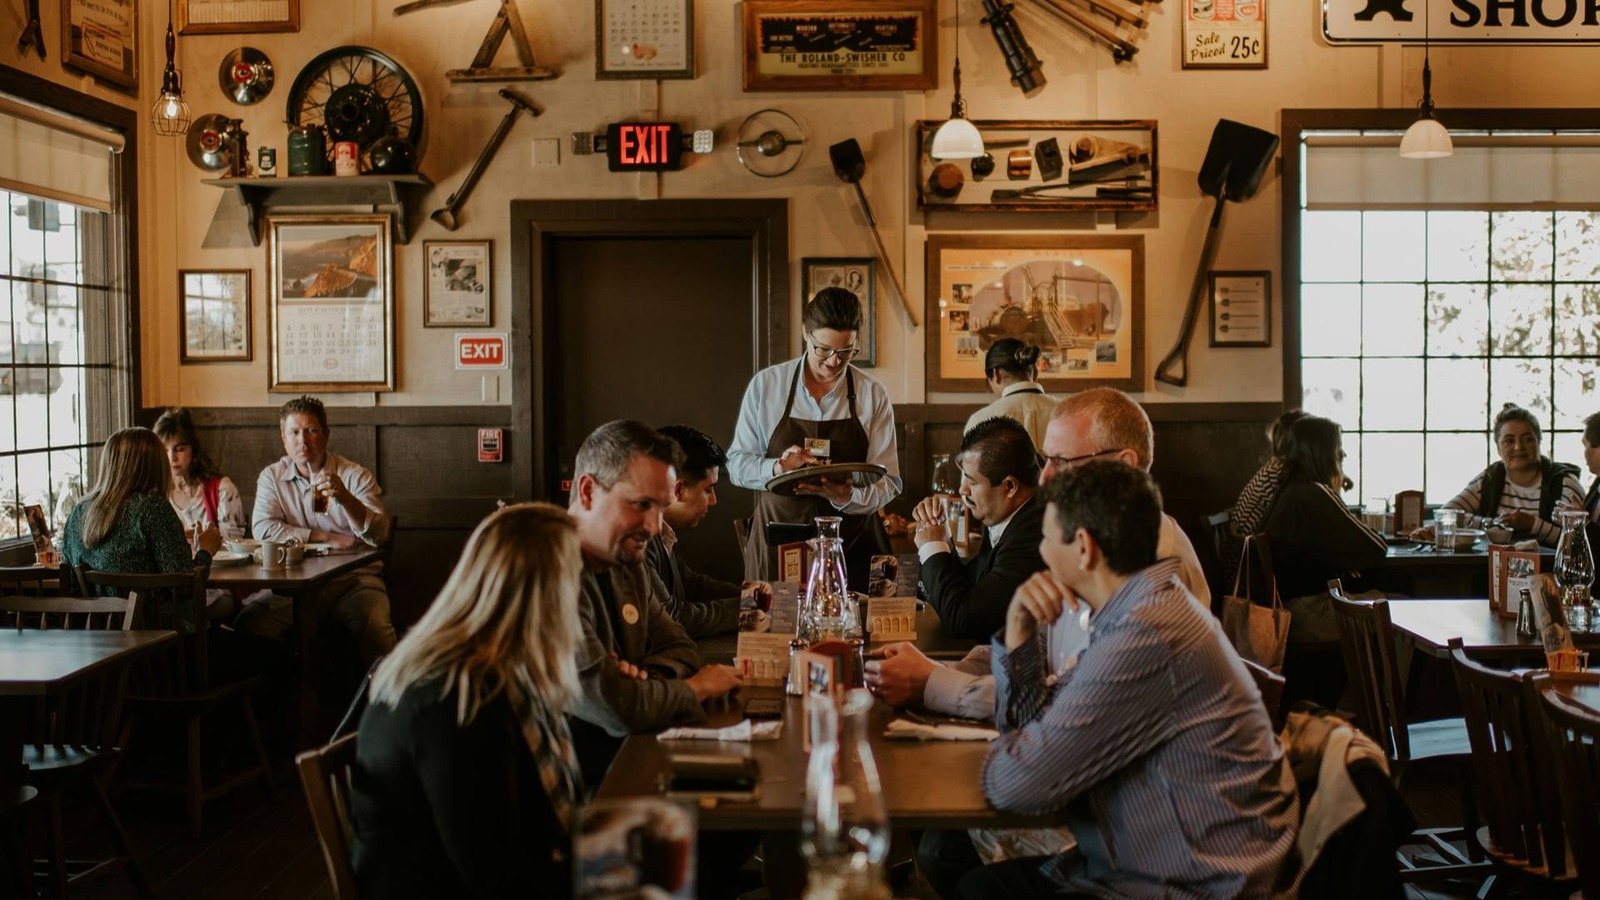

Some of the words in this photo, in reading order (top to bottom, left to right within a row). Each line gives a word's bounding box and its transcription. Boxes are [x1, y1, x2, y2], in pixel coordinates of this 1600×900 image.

[1195, 31, 1220, 47] Sale
[780, 53, 797, 64] THE
[802, 52, 888, 64] ROLAND-SWISHER
[892, 52, 906, 62] CO
[1191, 43, 1226, 61] Priced
[620, 125, 671, 165] EXIT
[461, 343, 501, 359] EXIT
[480, 430, 499, 439] FIRE
